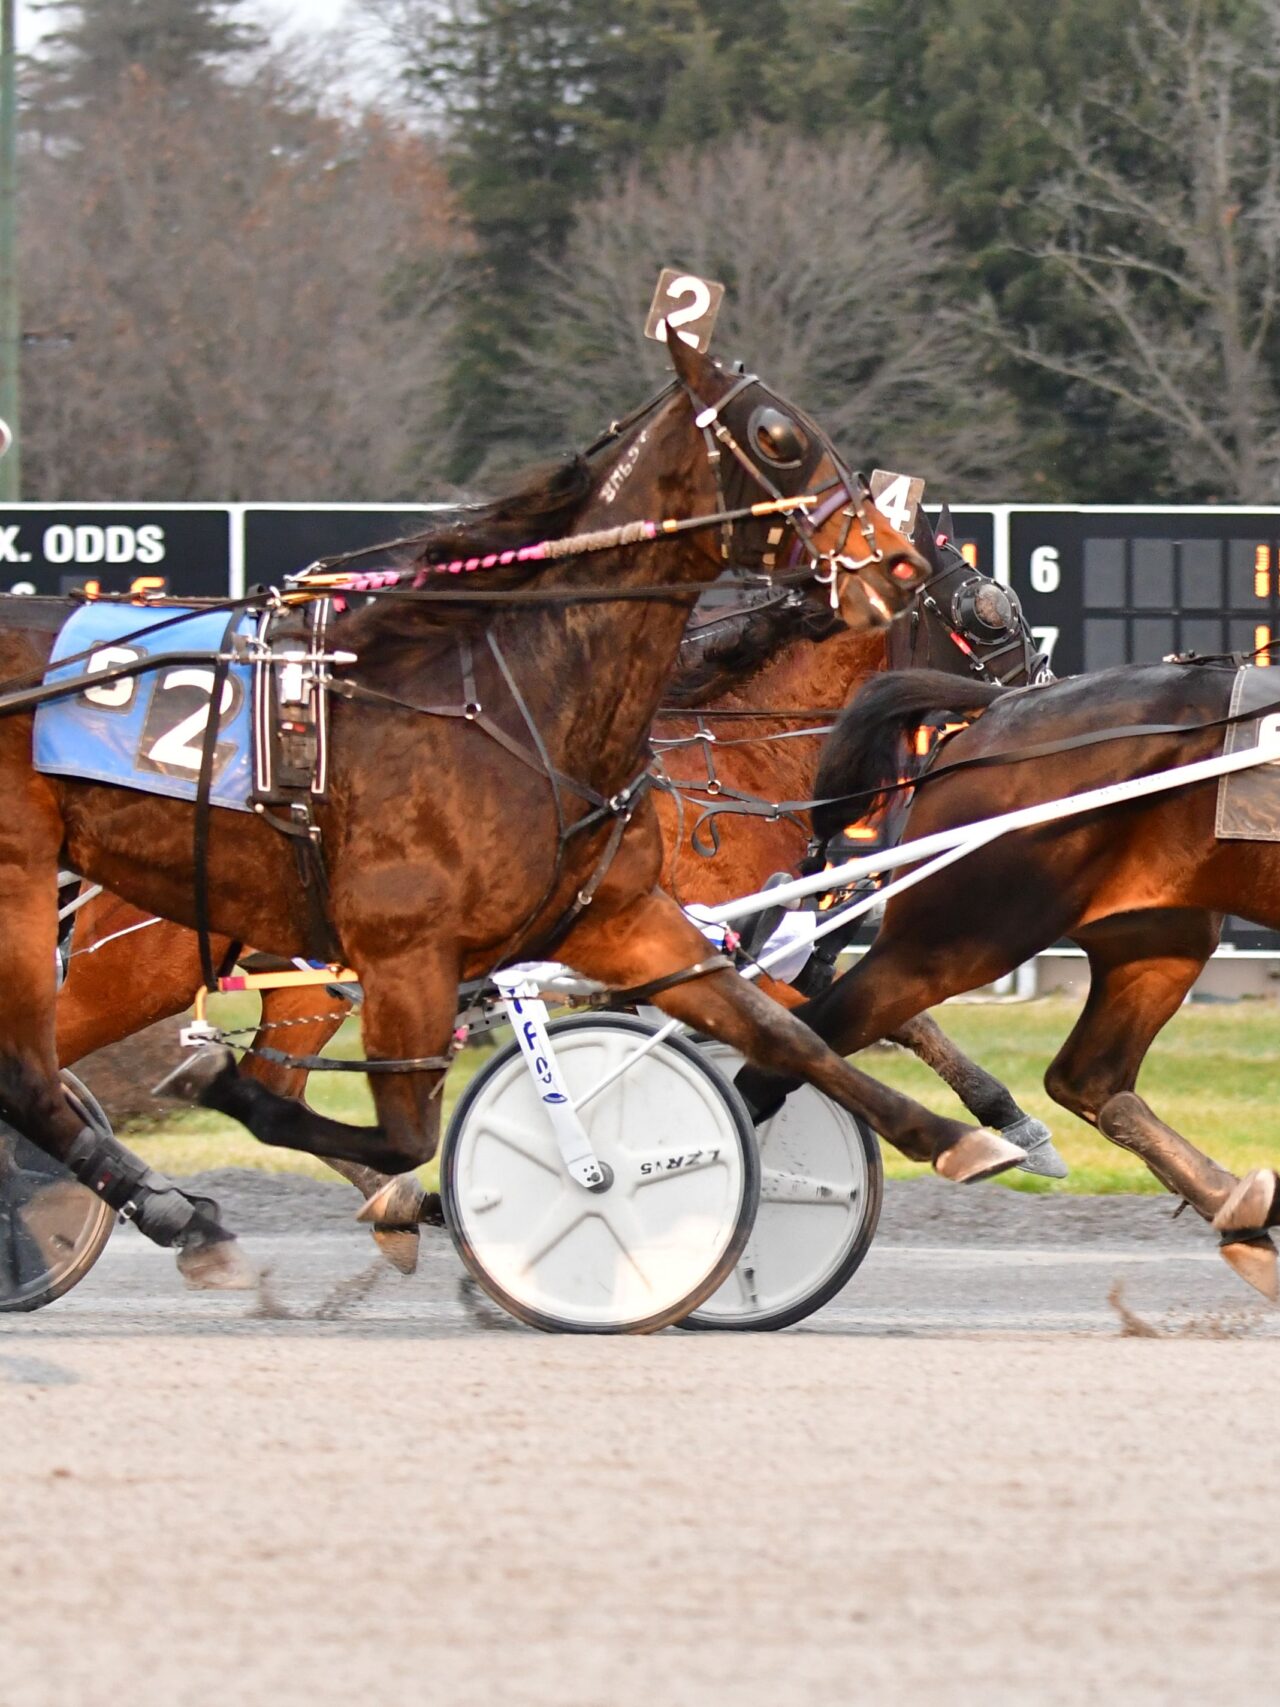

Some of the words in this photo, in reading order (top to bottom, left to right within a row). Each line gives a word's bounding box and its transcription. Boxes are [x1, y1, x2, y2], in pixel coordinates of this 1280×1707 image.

[655, 276, 711, 350] 2
[875, 474, 913, 534] 4
[43, 524, 166, 564] ODDS
[1030, 546, 1060, 593] 6
[1030, 626, 1060, 670] 7
[147, 669, 234, 770] 2
